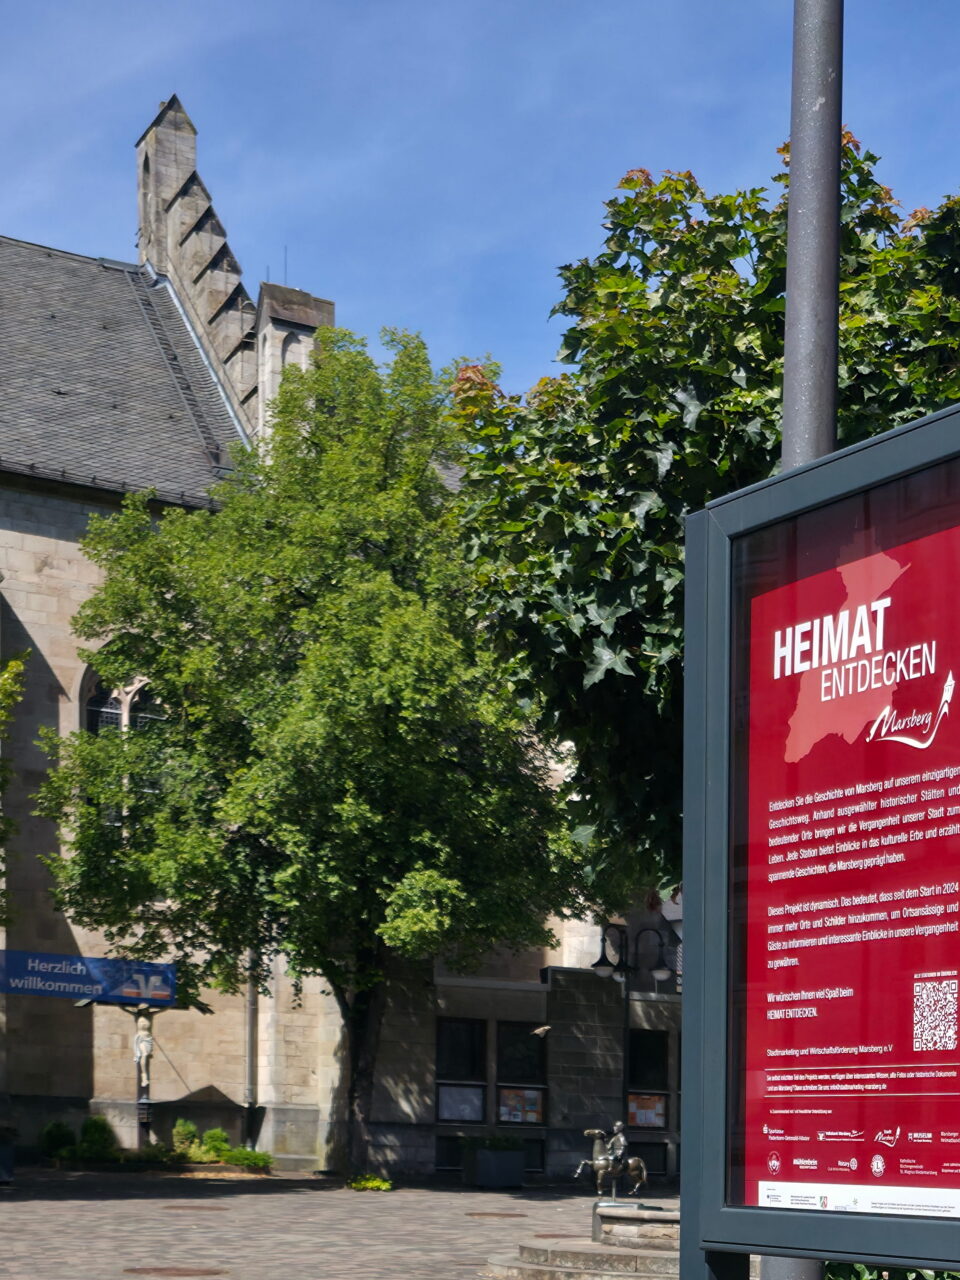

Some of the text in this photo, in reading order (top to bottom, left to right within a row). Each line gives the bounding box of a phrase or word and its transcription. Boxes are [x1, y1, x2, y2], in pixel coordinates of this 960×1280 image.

[774, 597, 892, 680] HEIMAT
[821, 641, 936, 702] ENTDECKEN
[866, 706, 932, 742] Marsberg
[768, 800, 794, 811] Entdecken
[795, 796, 804, 806] Sie
[804, 794, 813, 804] die
[814, 789, 844, 802] Geschichte
[844, 787, 855, 796] von
[855, 782, 883, 794] Marsberg
[884, 777, 894, 789] auf
[894, 774, 920, 787] unserem
[768, 784, 960, 829] Geschichtsweg. Anhand ausgewählter historischer Stätten und
[768, 806, 960, 846] bedeutender Orte bringen wir die Vergangenheit unserer Stadt zum
[768, 824, 960, 864] Leben. Jede Station bietet Einblicke in das kulturelle Erbe und erzählt
[768, 853, 906, 883] spannende Geschichten, die Marsberg geprägt haben.
[768, 882, 959, 916] Dieses Projekt ist dynamisch. Das bedeutet, dass seit dem Start in 2024
[768, 902, 959, 933] immer mehr Orte und Schilder hinzukommen, um Ortsansässige und
[768, 941, 781, 951] Gäste
[788, 938, 817, 948] informieren
[818, 935, 828, 945] und
[828, 932, 861, 944] interessante
[862, 929, 887, 940] Einblicke
[888, 929, 894, 938] in
[894, 928, 915, 937] unsere
[915, 921, 959, 936] Vergangenheit
[28, 959, 86, 975] Herzlich
[774, 957, 799, 969] gewähren.
[10, 976, 102, 995] willkommen
[767, 987, 854, 1002] Wir wünschen Ihnen viel Spaß beim
[767, 1009, 786, 1019] HEIMAT
[767, 1049, 799, 1057] Stadtmarketing
[859, 1045, 883, 1053] Marsberg
